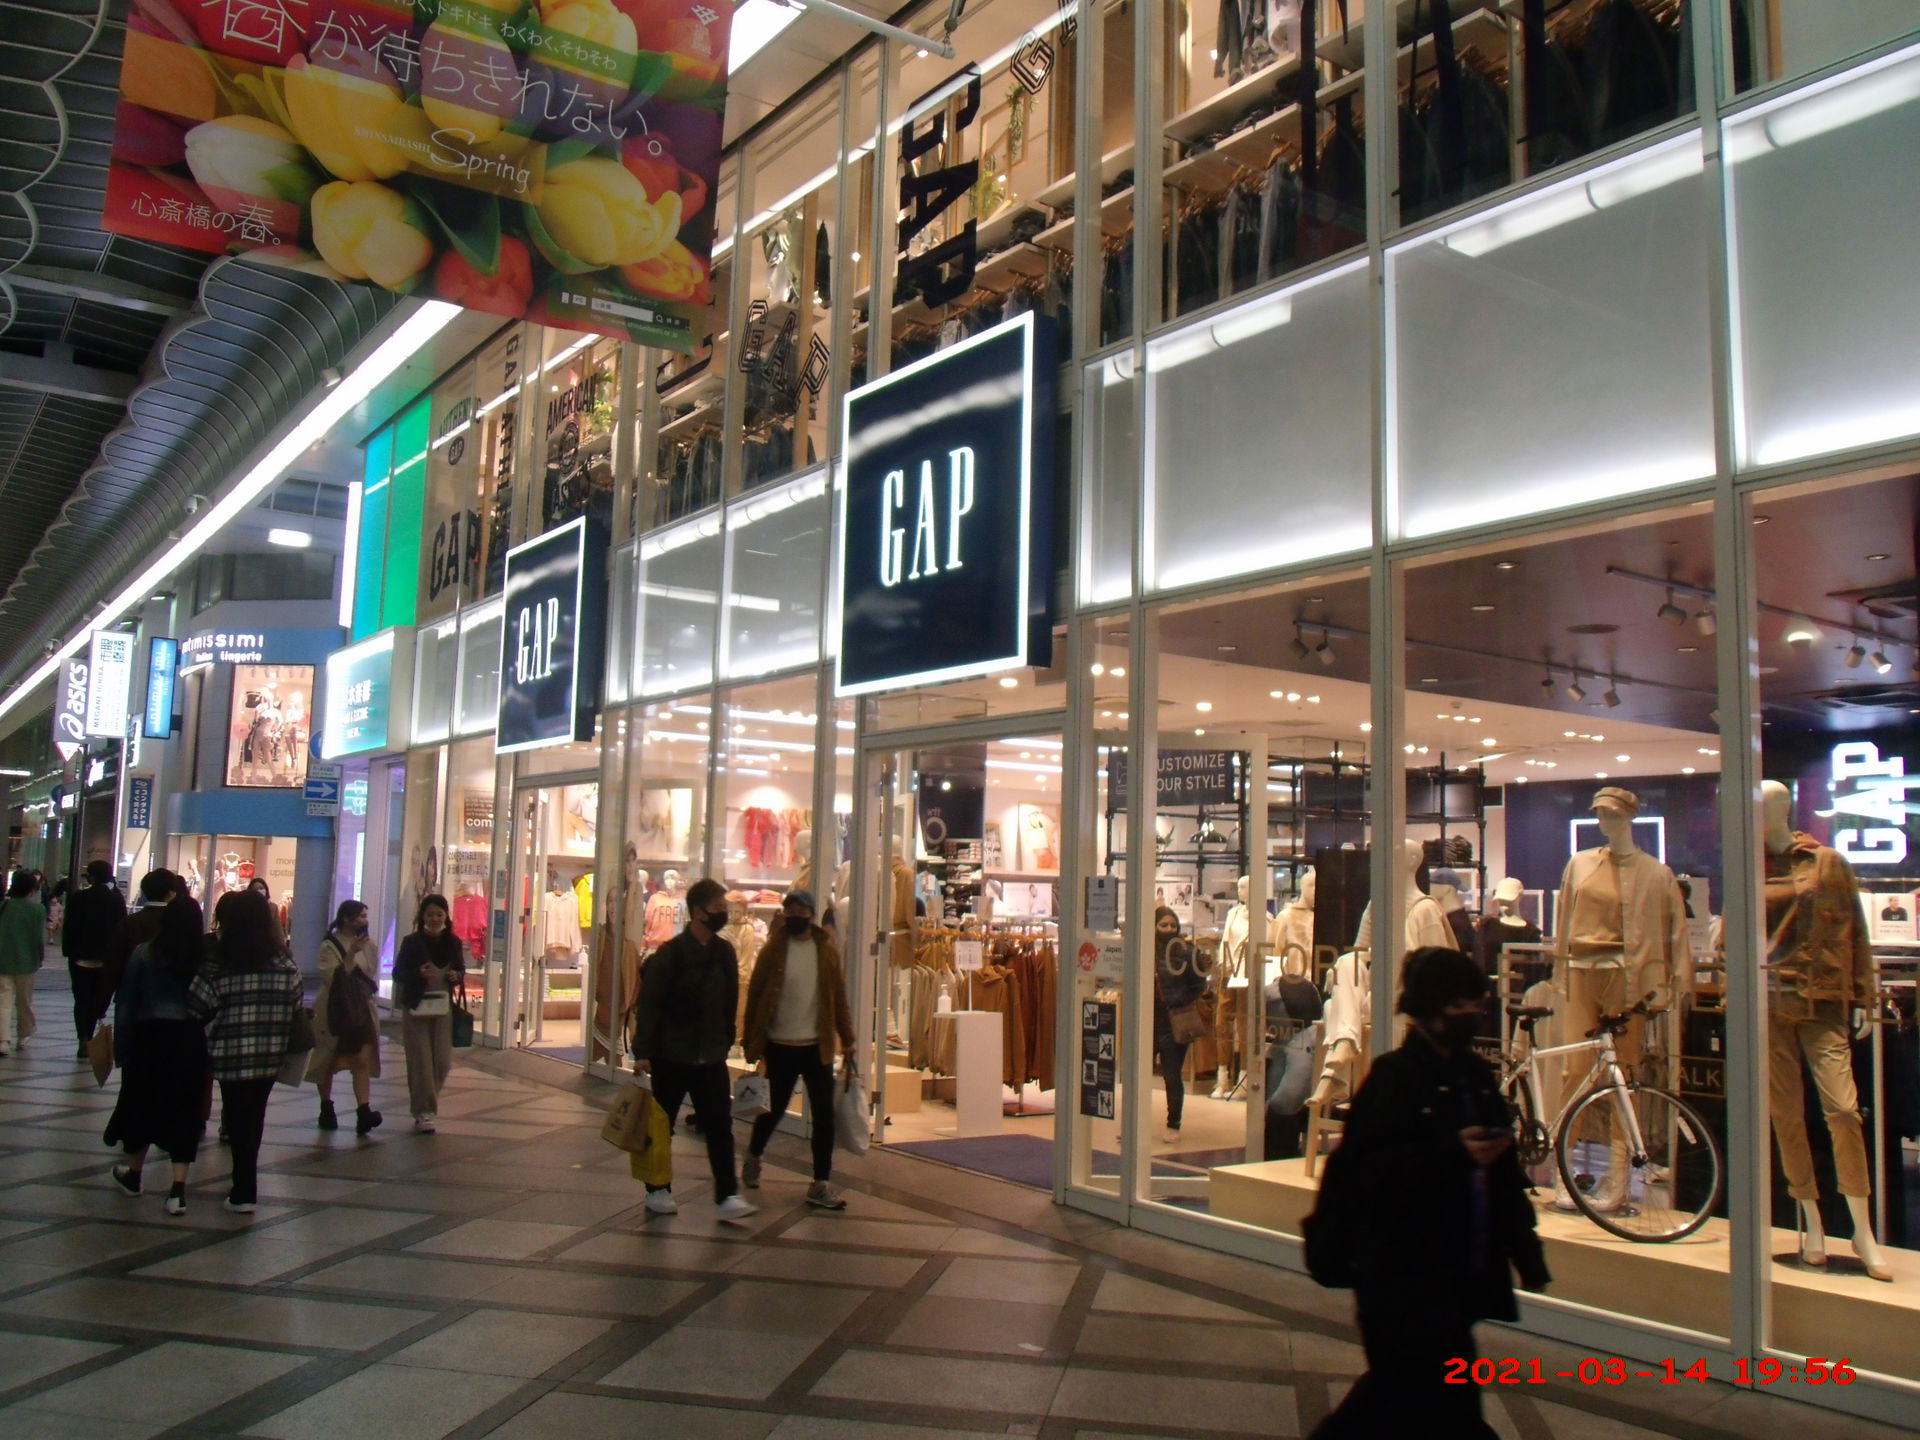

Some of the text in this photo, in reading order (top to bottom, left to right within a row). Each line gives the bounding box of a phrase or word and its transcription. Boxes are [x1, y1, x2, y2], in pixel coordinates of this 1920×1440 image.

[354, 126, 531, 193] SHINSAIBASHI Spring
[896, 61, 981, 309] GAP
[131, 190, 281, 246] 心斎橋の春。
[738, 299, 830, 412] GAP
[881, 446, 975, 587] GAP
[430, 509, 482, 602] GAP
[517, 597, 559, 685] GAP
[66, 662, 88, 715] asics
[1157, 753, 1225, 772] USTOMIZE
[1157, 774, 1226, 792] OUR STYLE
[1831, 741, 1908, 864] GAP
[1165, 936, 1369, 987] COMFORT
[1678, 1066, 1722, 1088] ALK
